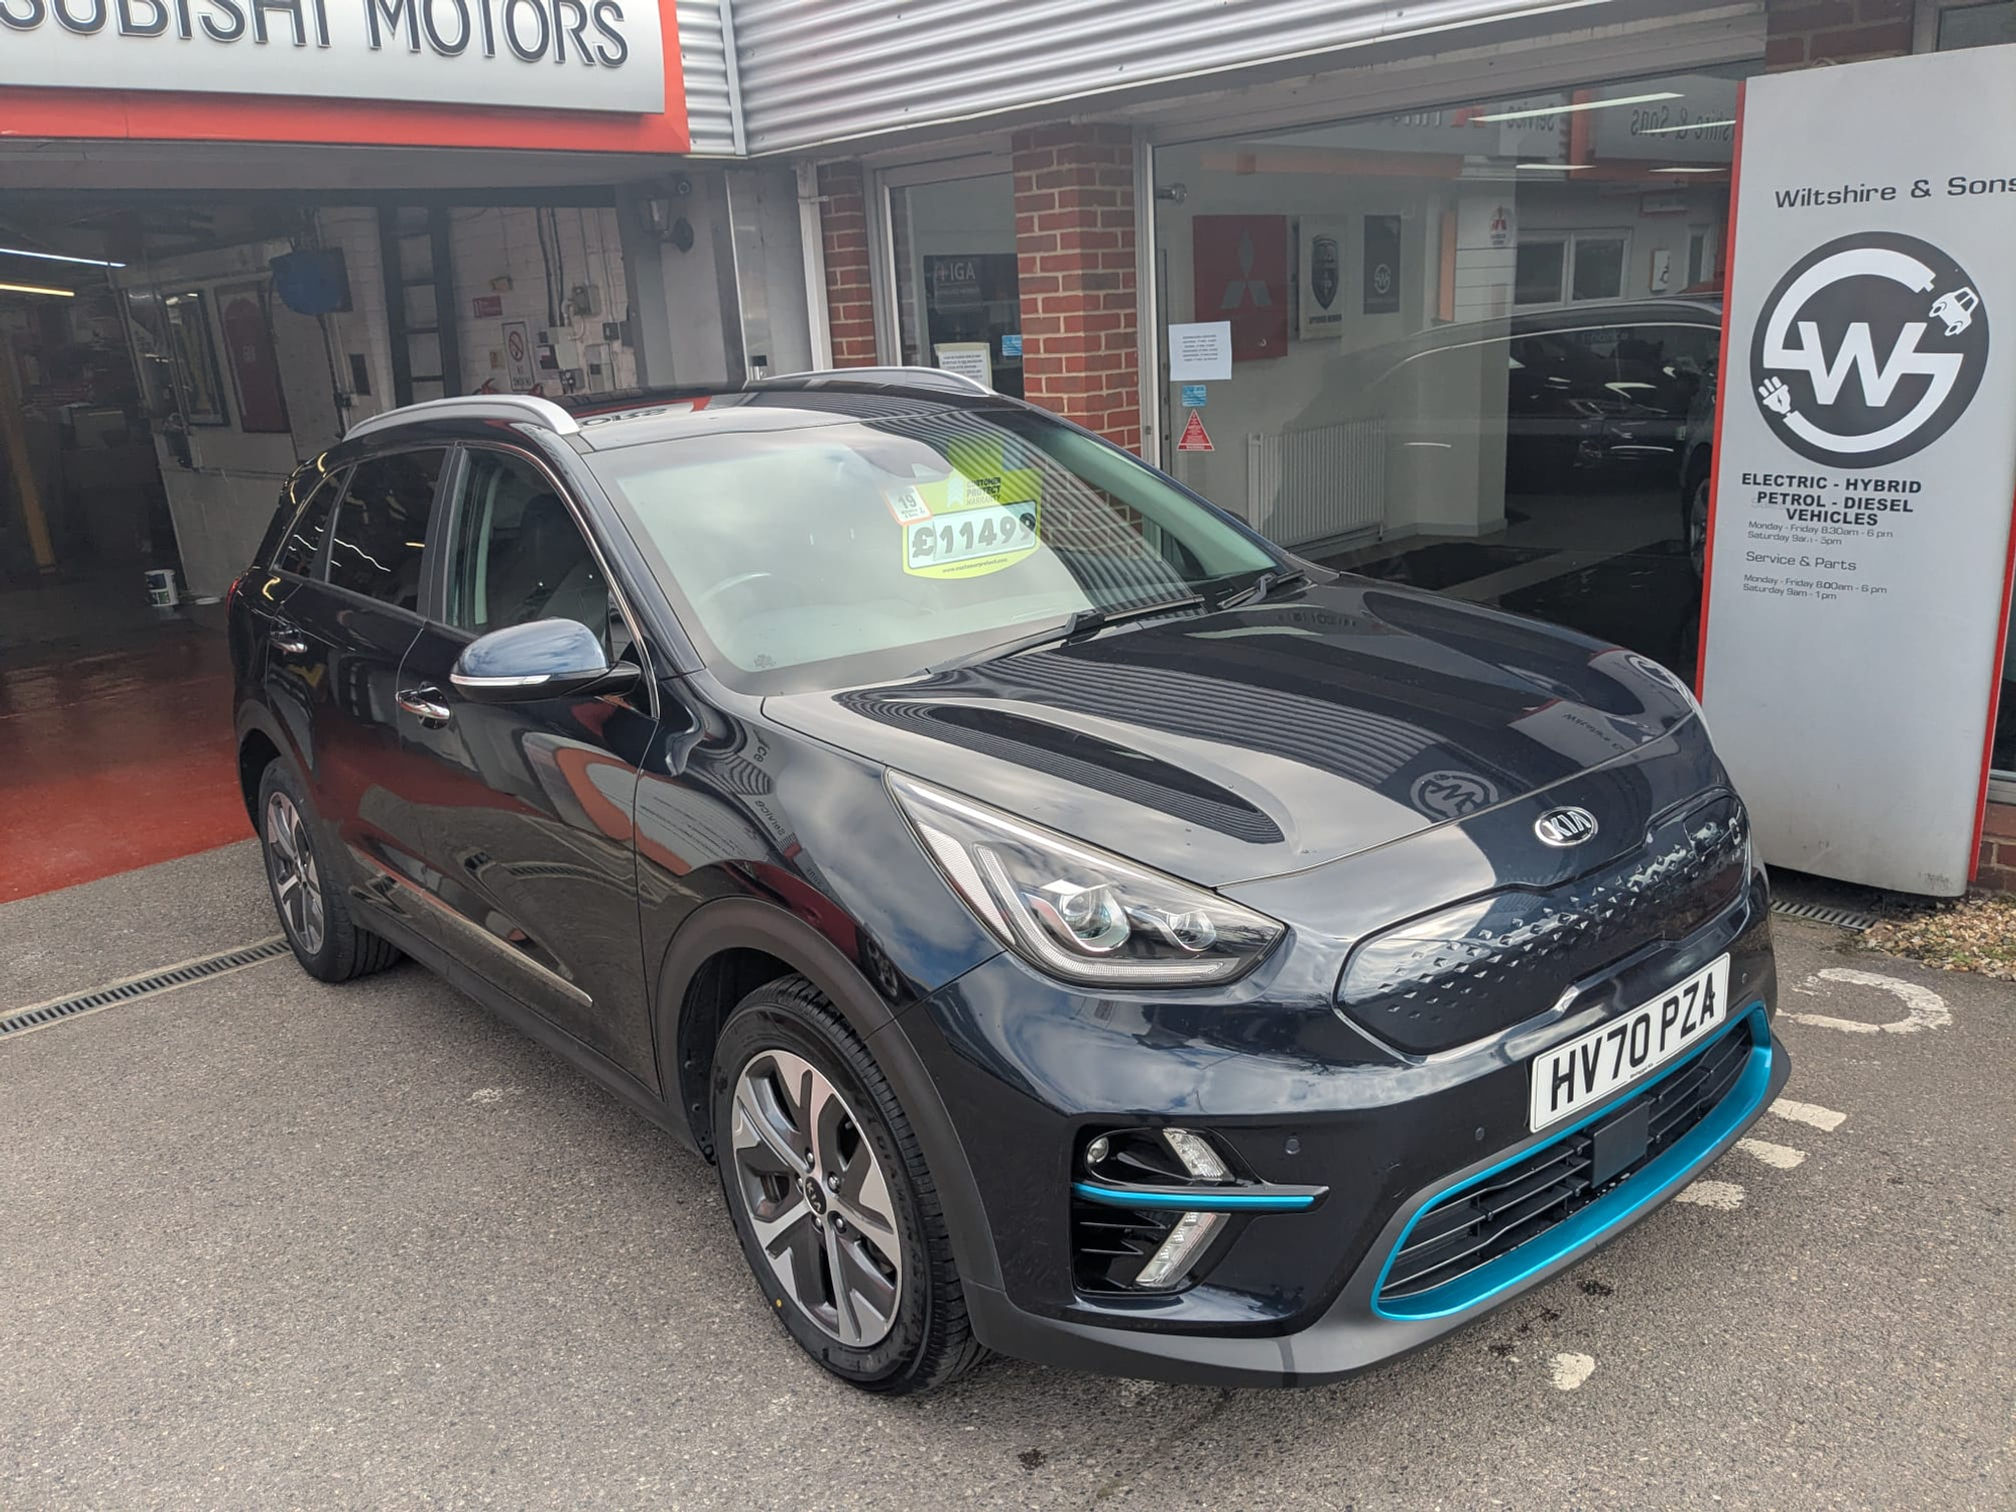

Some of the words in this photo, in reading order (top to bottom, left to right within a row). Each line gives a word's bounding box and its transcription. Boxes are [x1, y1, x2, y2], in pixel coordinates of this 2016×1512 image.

[365, 0, 628, 67] MOTORS
[1775, 184, 1897, 208] Wiltshire
[1910, 179, 1932, 198] &
[1741, 473, 1827, 489] ELECTRIC
[1845, 478, 1921, 493] HYBRID
[1757, 491, 1826, 508] PETROL
[1844, 497, 1913, 512] DIESEL
[1786, 508, 1878, 526] VEHICLES
[912, 512, 1036, 559] £11499
[1747, 531, 1789, 543] Saturday
[1748, 521, 1783, 532] Monday
[1790, 524, 1818, 535] Friday
[1745, 551, 1796, 566] Service
[1799, 556, 1810, 567] &
[1815, 557, 1857, 571] Parts
[1743, 584, 1784, 596] Saturday
[1787, 588, 1807, 597] 9am
[1744, 574, 1778, 586] Monday
[1785, 577, 1814, 589] Friday
[1542, 811, 1591, 840] KIA
[1551, 1012, 1651, 1112] HV70
[1659, 971, 1715, 1053] PZA
